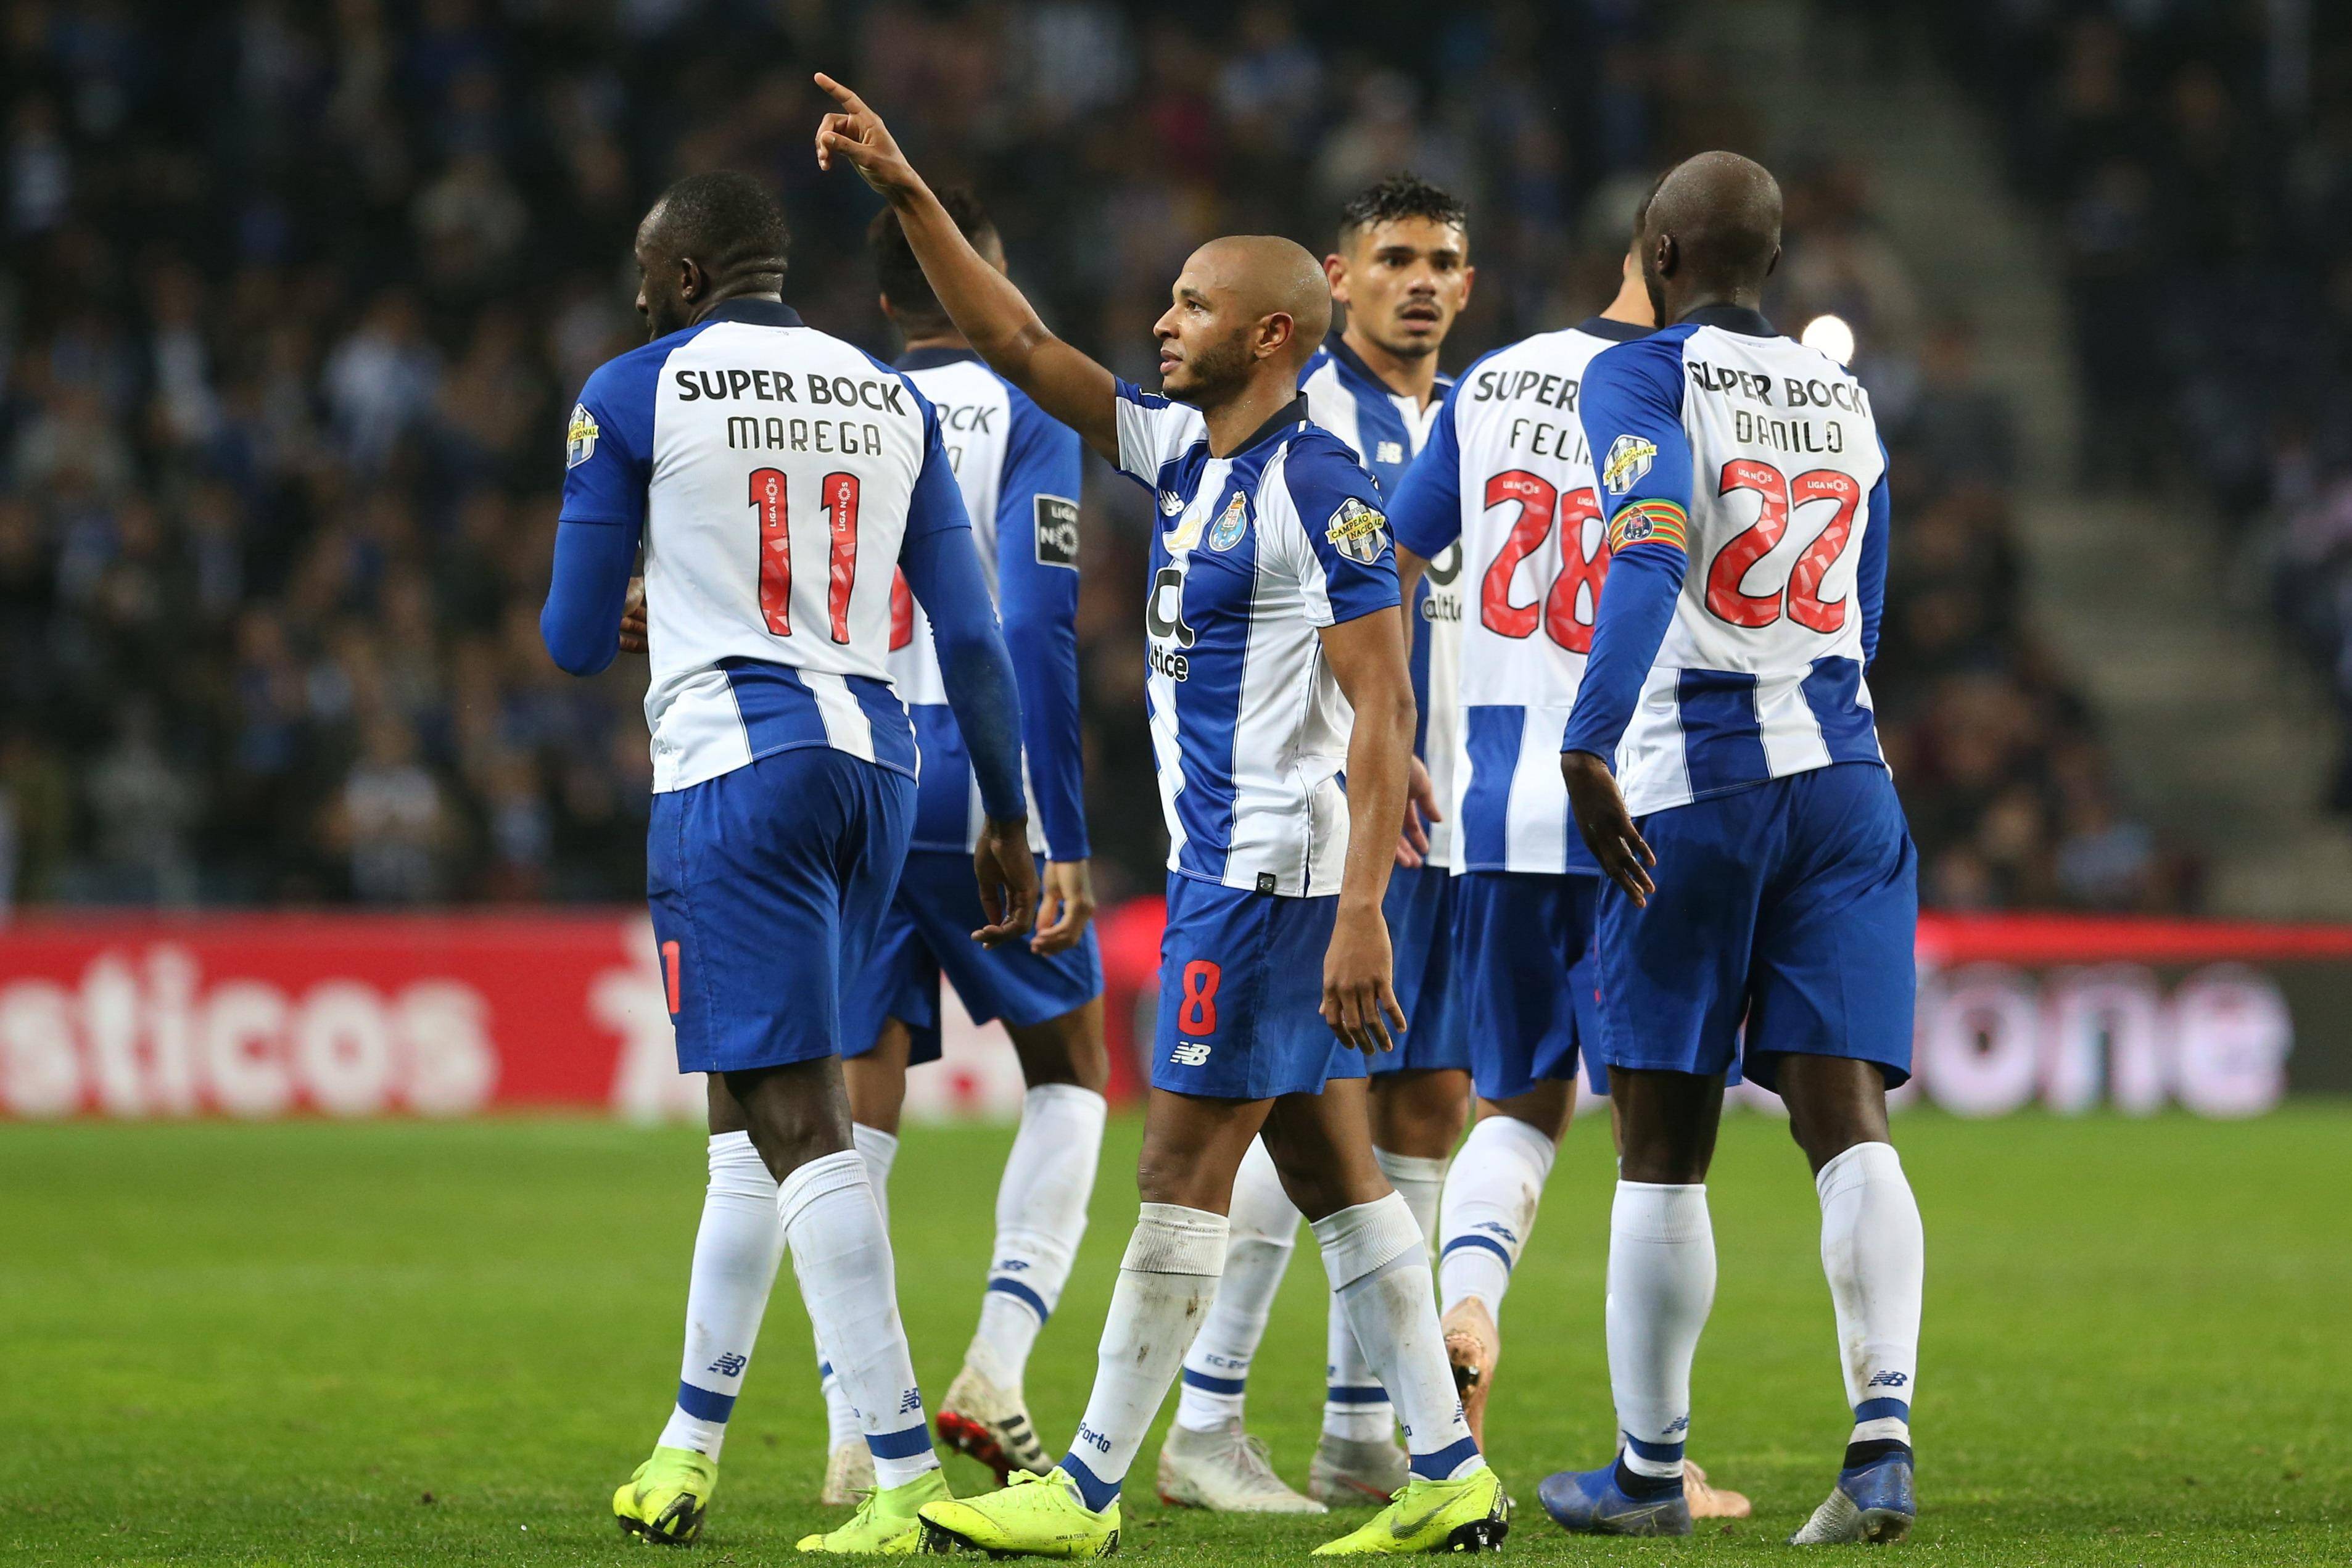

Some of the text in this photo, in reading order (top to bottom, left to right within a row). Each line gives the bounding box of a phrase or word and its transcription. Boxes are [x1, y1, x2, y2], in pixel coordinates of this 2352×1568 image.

[675, 370, 907, 416] SUPER BOCK
[1474, 371, 1580, 413] SUPER
[1783, 378, 1867, 418] BOCK
[727, 416, 882, 456] MAREGA
[936, 404, 998, 435] OCK
[1736, 410, 1843, 453] DANILO
[1510, 418, 1592, 466] FELI
[765, 477, 778, 504] NOS
[838, 481, 851, 532] LIGA NOS
[1807, 479, 1849, 492] LIGA NOS
[748, 467, 860, 645] 11
[1040, 522, 1079, 556] NO
[1704, 458, 1860, 635] 22
[1481, 469, 1612, 654] 28
[1178, 959, 1222, 1037] 8
[1076, 1422, 1112, 1453] Porto
